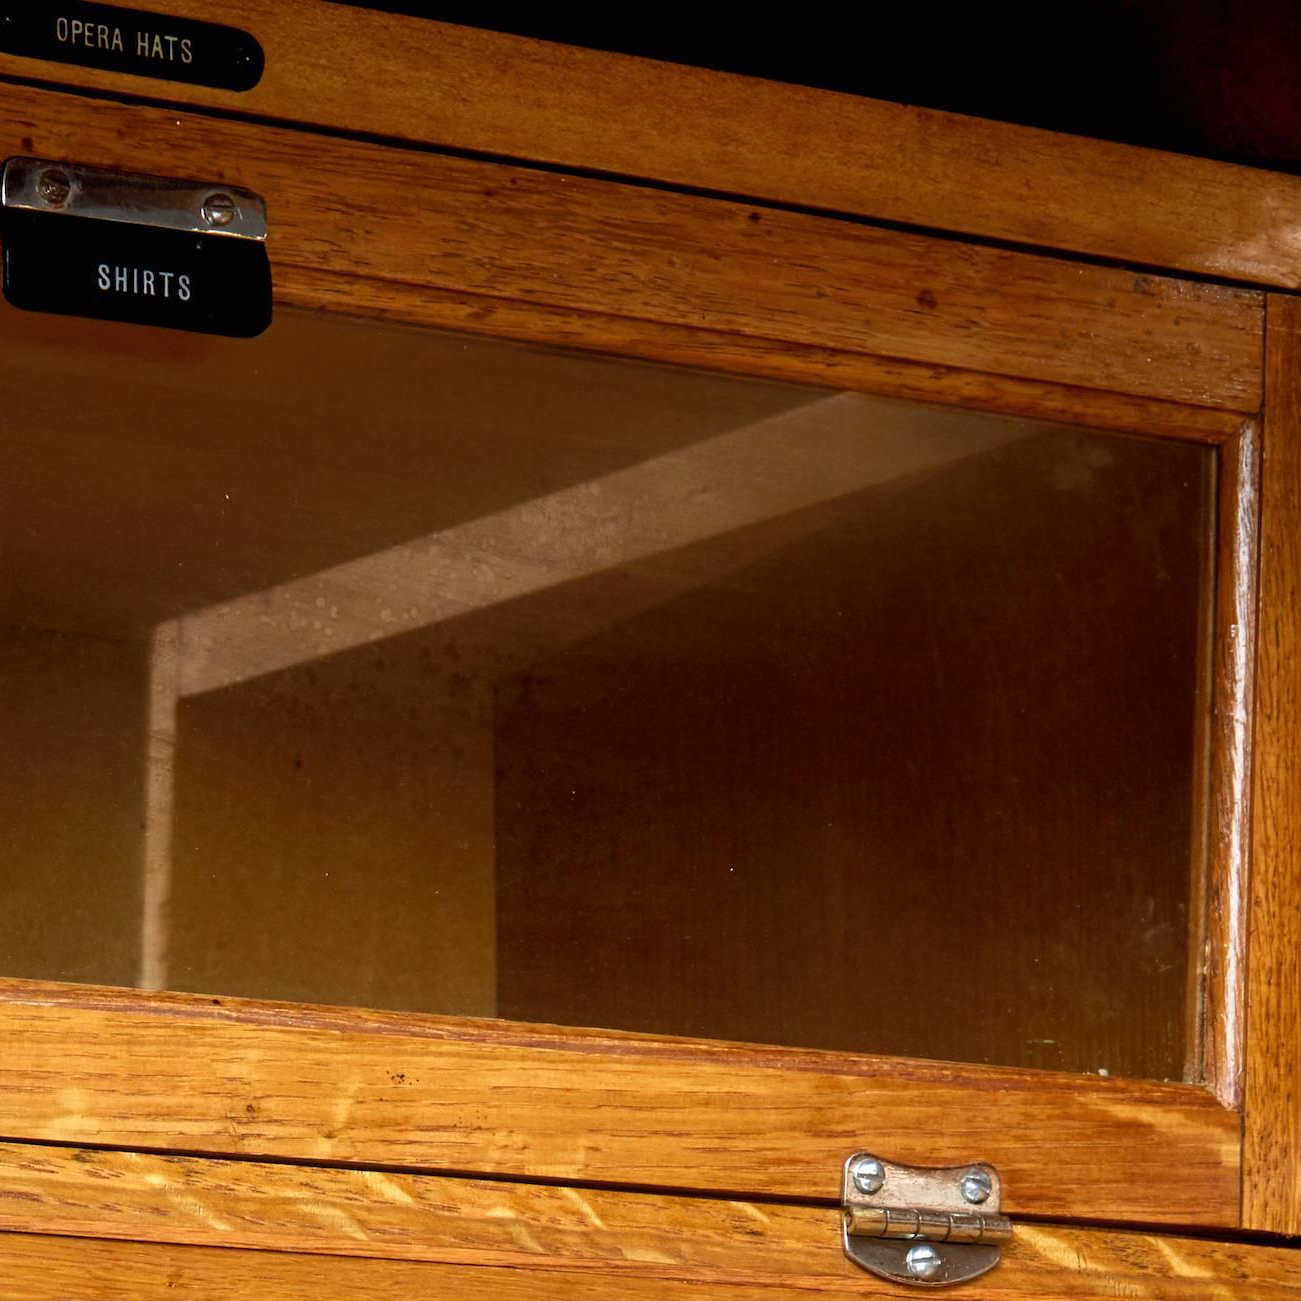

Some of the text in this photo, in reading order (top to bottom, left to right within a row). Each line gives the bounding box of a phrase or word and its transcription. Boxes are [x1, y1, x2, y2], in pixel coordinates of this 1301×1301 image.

[56, 17, 193, 64] OPERA HATS
[97, 263, 192, 301] SHIRTS
